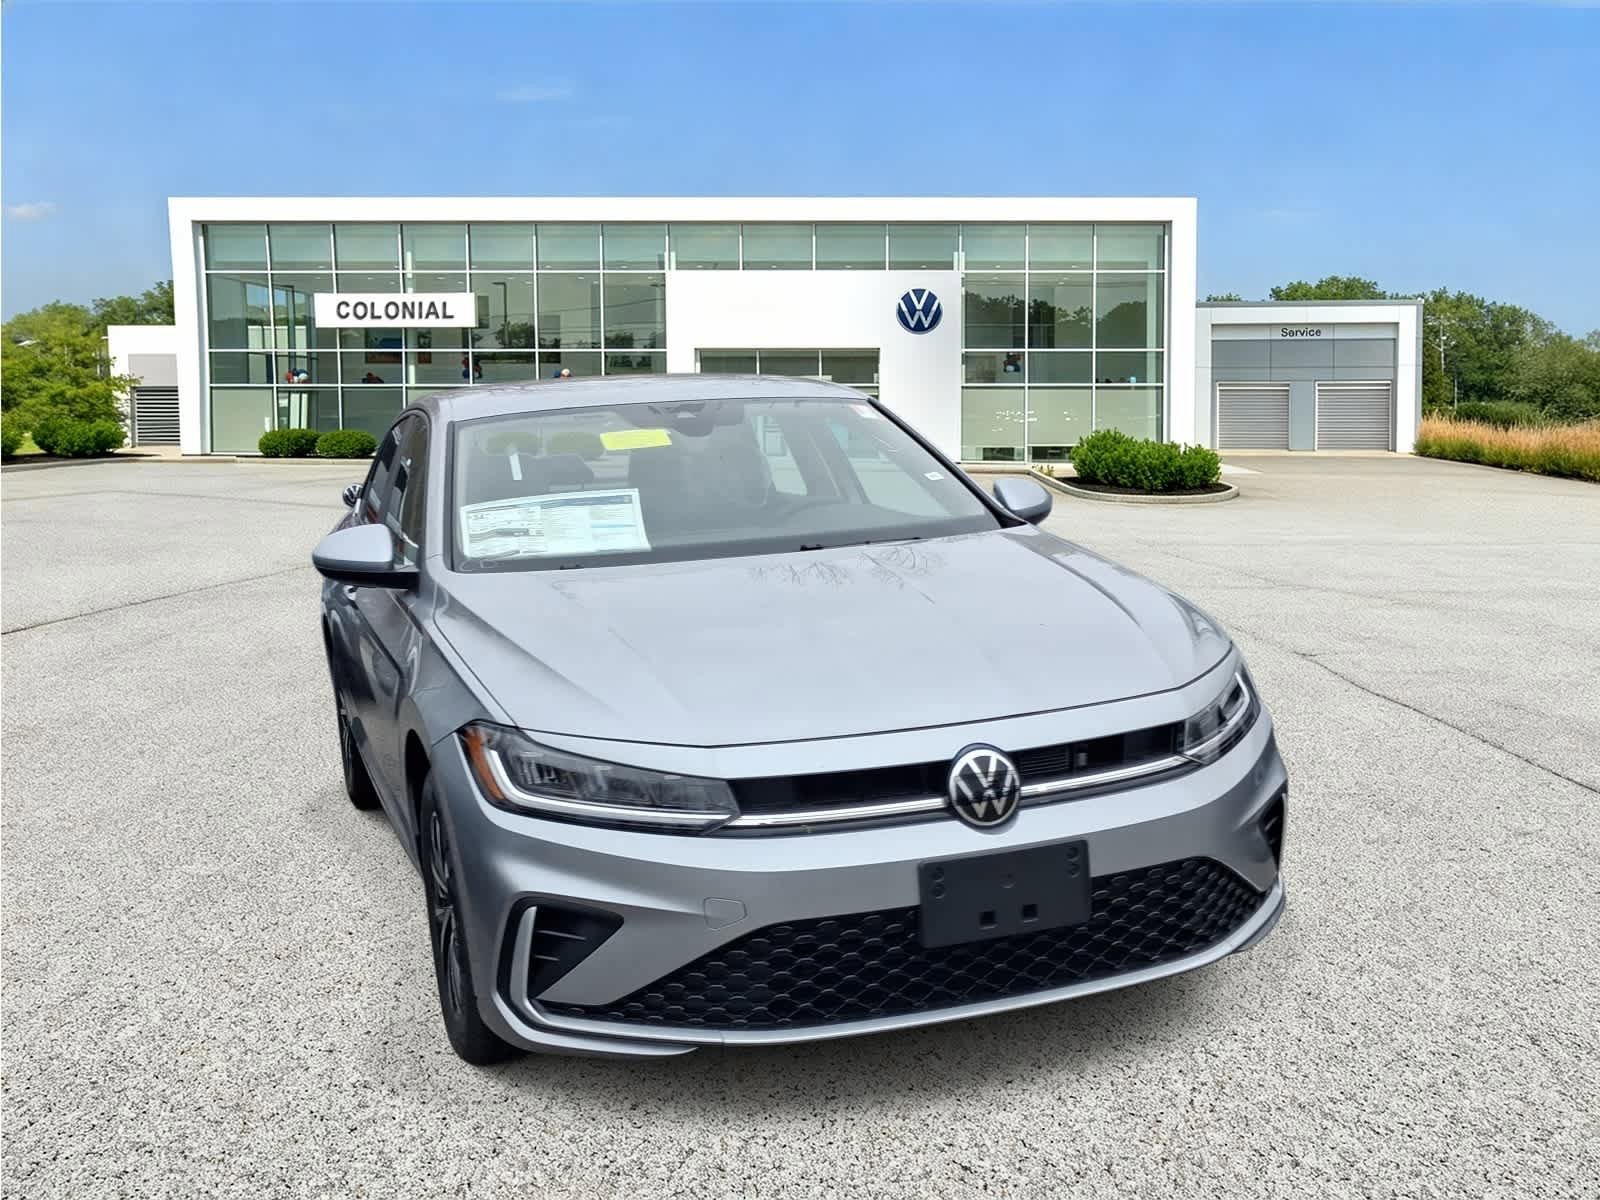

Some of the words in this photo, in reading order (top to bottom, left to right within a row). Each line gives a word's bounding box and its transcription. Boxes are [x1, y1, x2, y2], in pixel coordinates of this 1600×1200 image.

[336, 301, 455, 320] COLONIAL
[898, 288, 941, 330] VW
[1280, 327, 1321, 337] Service
[952, 752, 1017, 820] VW
